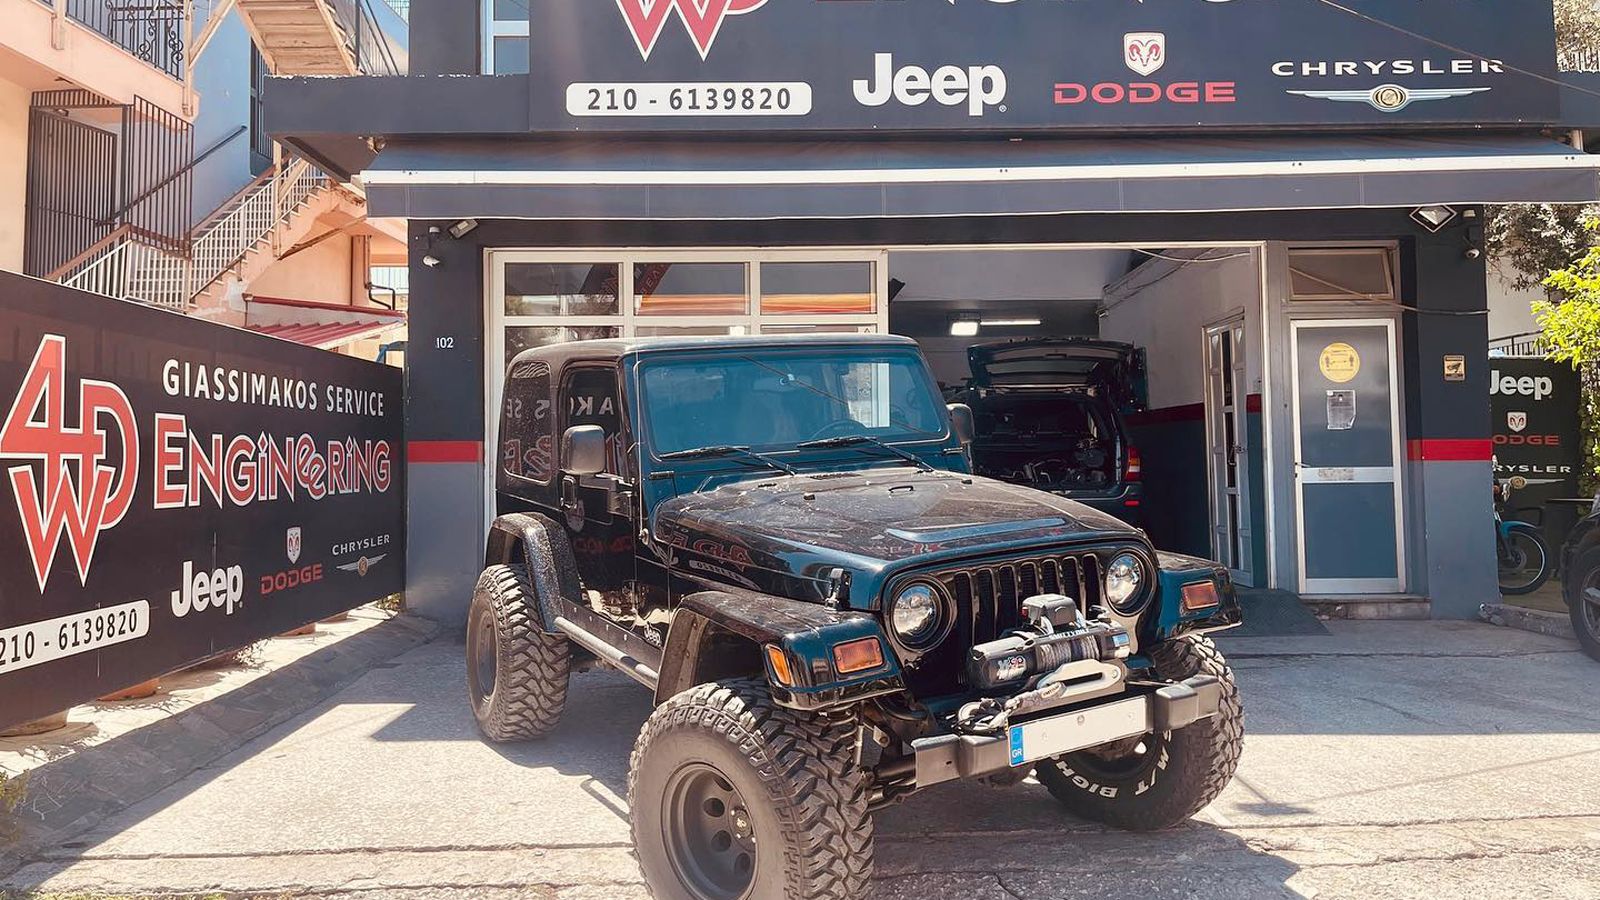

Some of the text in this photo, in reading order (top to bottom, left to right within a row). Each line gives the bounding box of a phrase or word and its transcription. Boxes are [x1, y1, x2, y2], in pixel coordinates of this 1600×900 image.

[1272, 59, 1504, 76] CHRYSLER
[853, 53, 1005, 115] Jeep
[1054, 82, 1236, 103] DODGE
[588, 88, 637, 111] 210
[670, 88, 790, 111] 6139820
[436, 337, 454, 349] 102
[162, 359, 384, 417] GIASSIMAKOS SERVICE
[1490, 370, 1552, 400] Jeep
[1492, 435, 1560, 445] ODGE
[1493, 464, 1571, 473] RYSLER
[332, 534, 391, 556] CHRYSLER
[171, 561, 243, 617] Jeep
[260, 563, 323, 595] DODGE
[58, 608, 138, 651] 6139820
[1011, 748, 1023, 758] GR
[1053, 754, 1118, 798] BIGH
